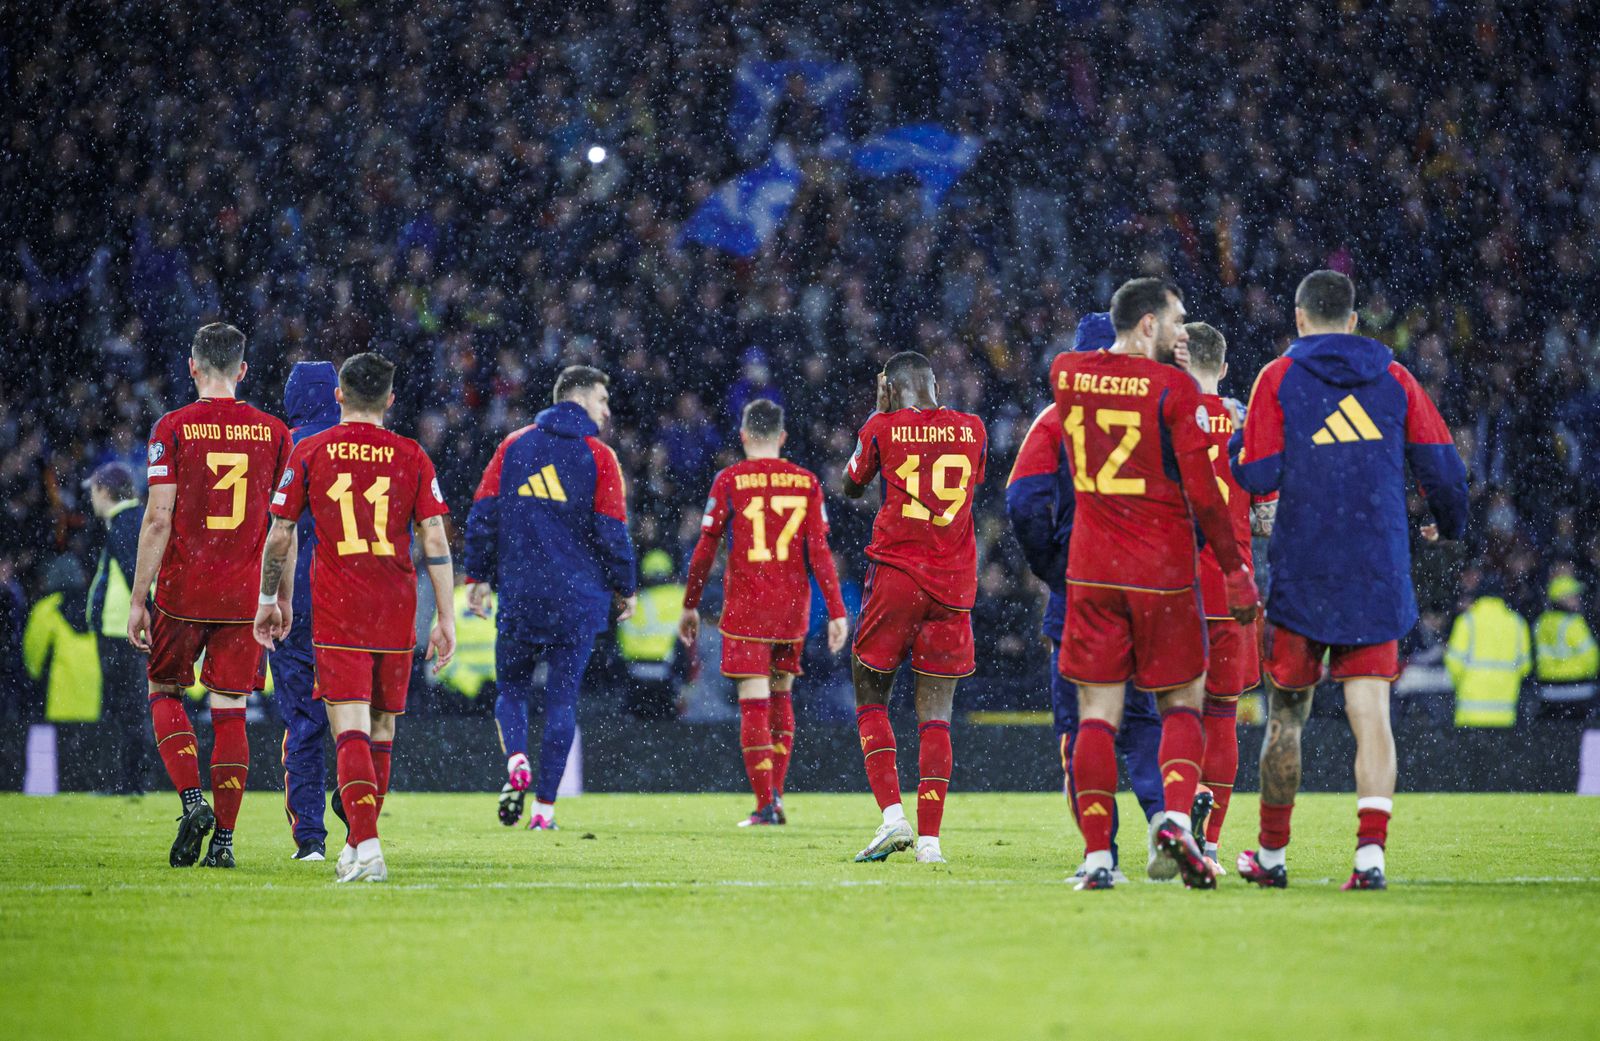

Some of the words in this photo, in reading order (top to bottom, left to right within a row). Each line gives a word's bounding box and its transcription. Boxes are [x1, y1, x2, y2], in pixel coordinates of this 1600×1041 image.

[1058, 371, 1070, 390] B.
[1073, 373, 1150, 397] IGLESIAS
[183, 423, 221, 441] DAVID
[225, 422, 272, 442] GARCÍA
[326, 442, 395, 464] YEREMY
[891, 426, 956, 443] WILLIAMS
[959, 426, 977, 443] JR.
[1063, 405, 1146, 495] 12
[206, 452, 249, 530] 3
[734, 472, 768, 490] IAGO
[770, 472, 812, 489] ASPAS
[895, 454, 972, 527] 19
[326, 472, 396, 557] 11
[742, 495, 808, 562] 17
